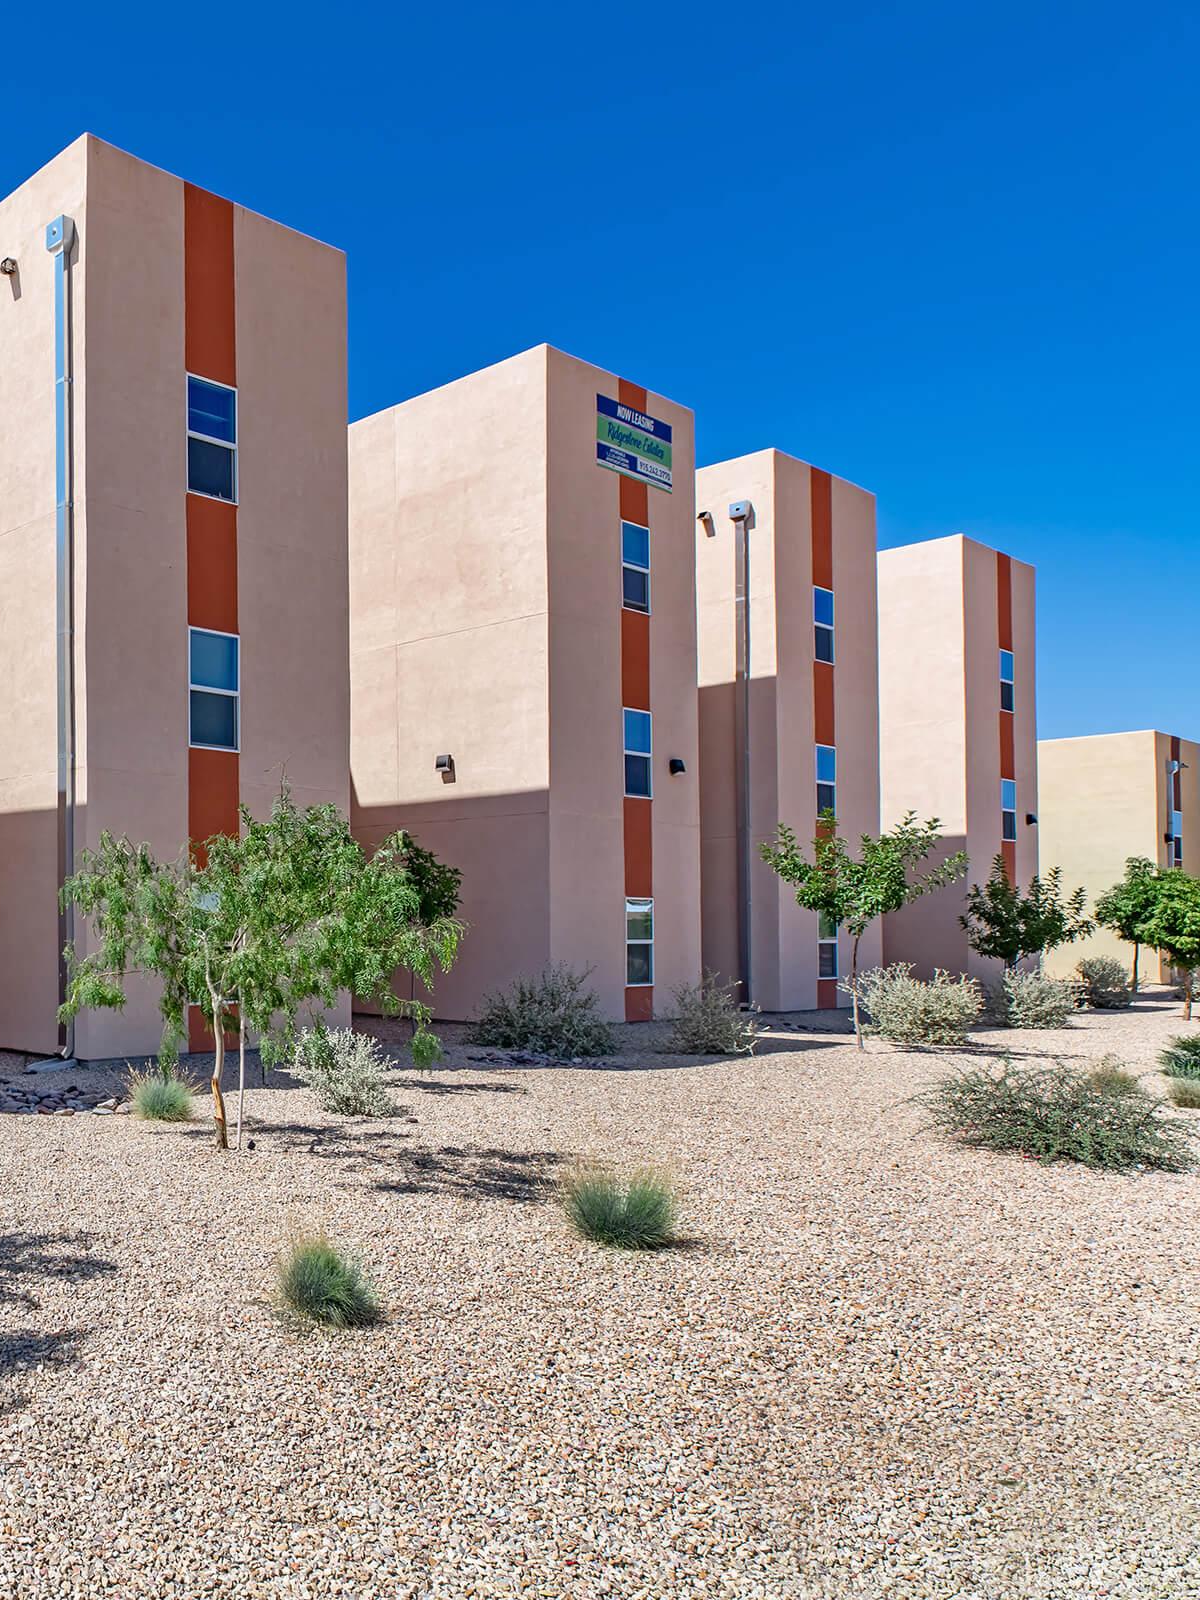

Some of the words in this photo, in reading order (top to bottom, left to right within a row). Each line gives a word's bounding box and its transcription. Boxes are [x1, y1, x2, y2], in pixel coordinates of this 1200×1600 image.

[617, 404, 631, 422] NOW
[631, 411, 654, 432] LEASING
[608, 421, 642, 449] Ridgestone
[642, 437, 664, 460] Estates
